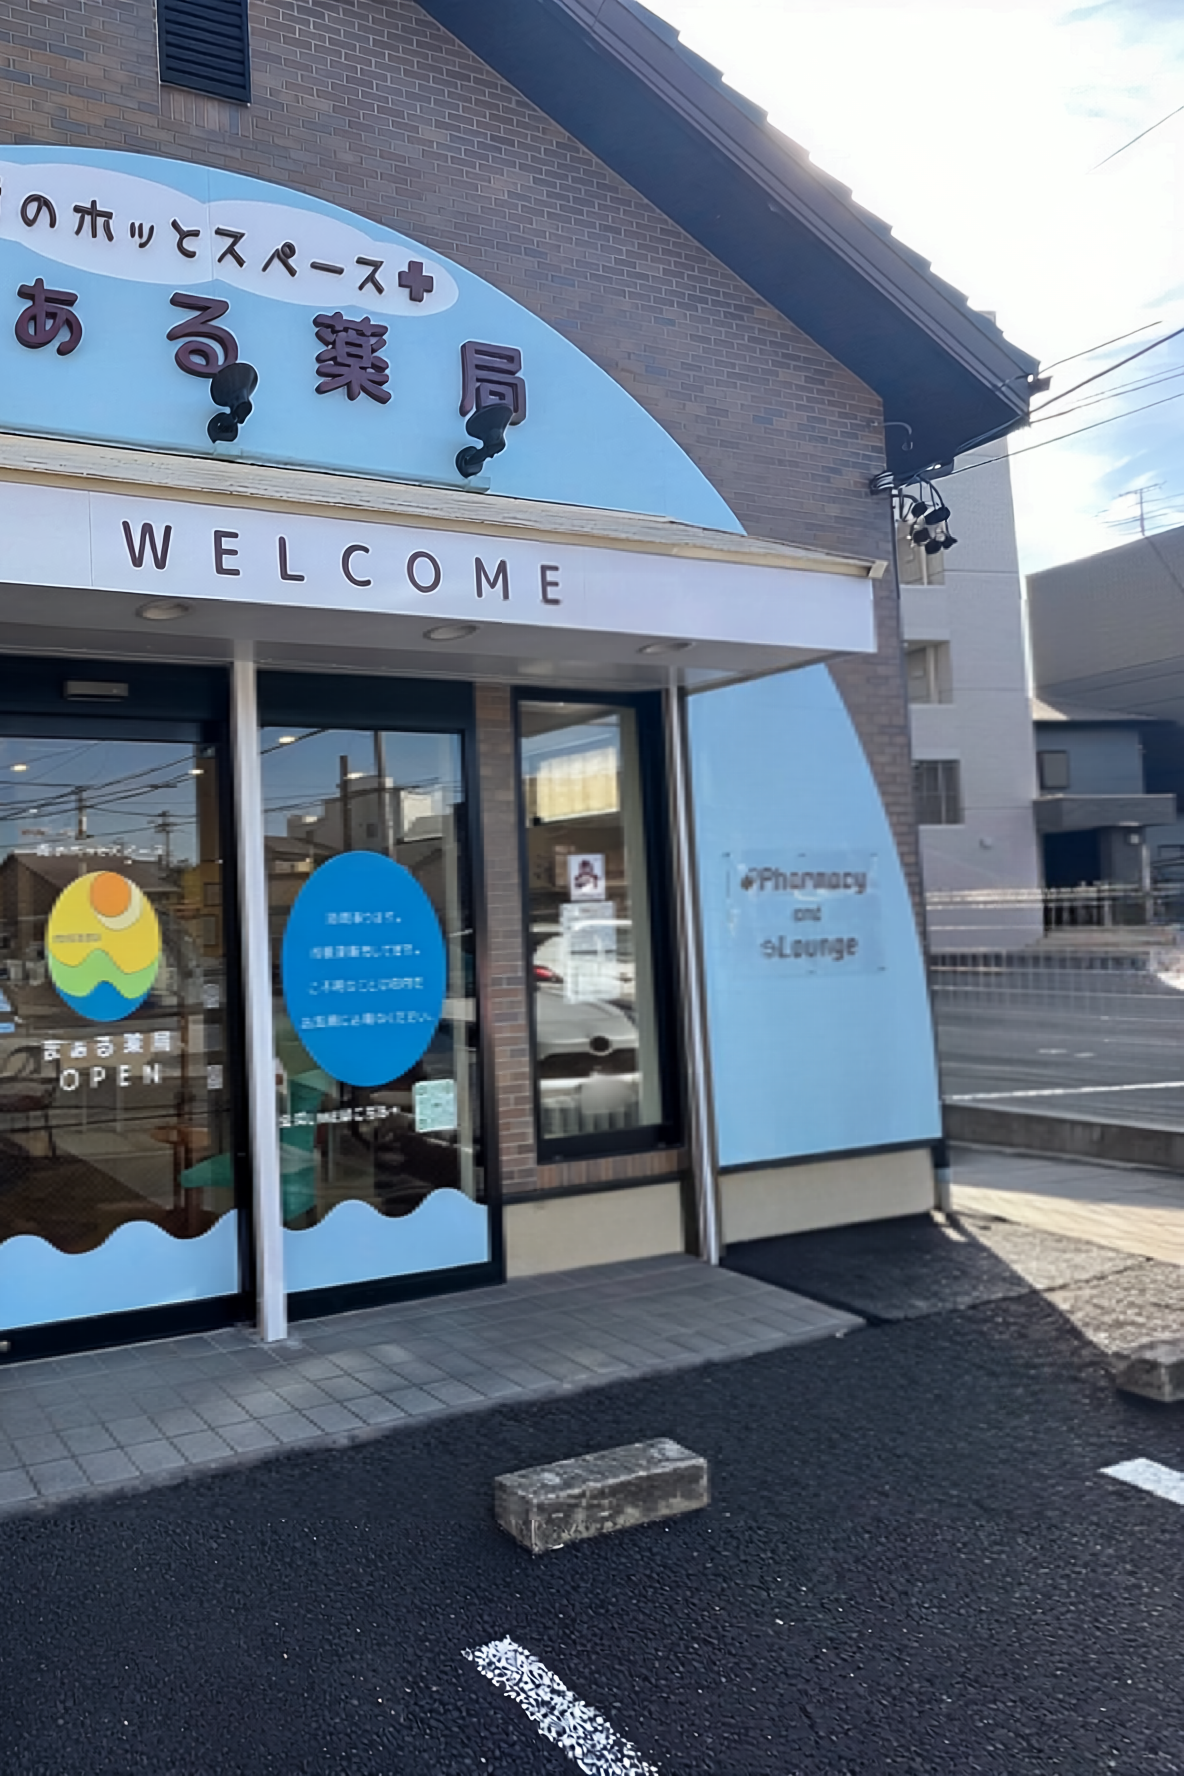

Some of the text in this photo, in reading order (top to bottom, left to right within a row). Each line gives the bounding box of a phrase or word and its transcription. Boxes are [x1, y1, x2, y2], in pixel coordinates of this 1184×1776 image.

[122, 519, 562, 605] WELCOME
[759, 866, 867, 894] Pharmacy
[60, 1063, 161, 1091] OPEN
